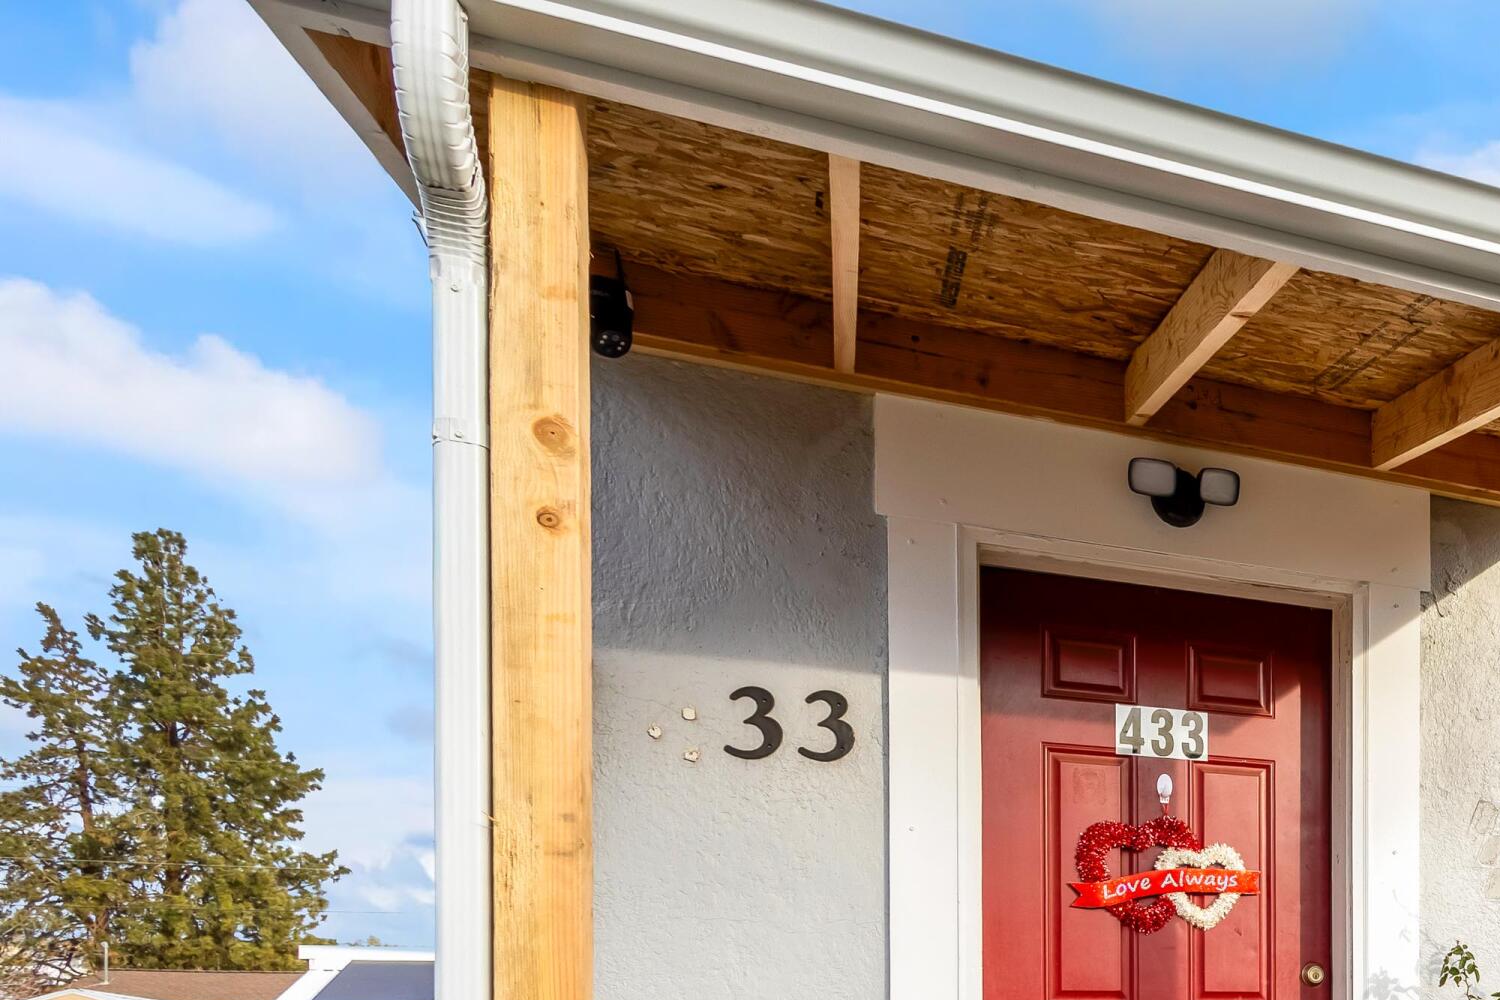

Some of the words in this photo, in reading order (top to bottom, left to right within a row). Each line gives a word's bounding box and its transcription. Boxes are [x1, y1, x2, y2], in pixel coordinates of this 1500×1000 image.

[723, 686, 856, 762] 33
[1119, 708, 1205, 759] 433
[1103, 877, 1151, 900] Love
[1160, 871, 1239, 893] Always
